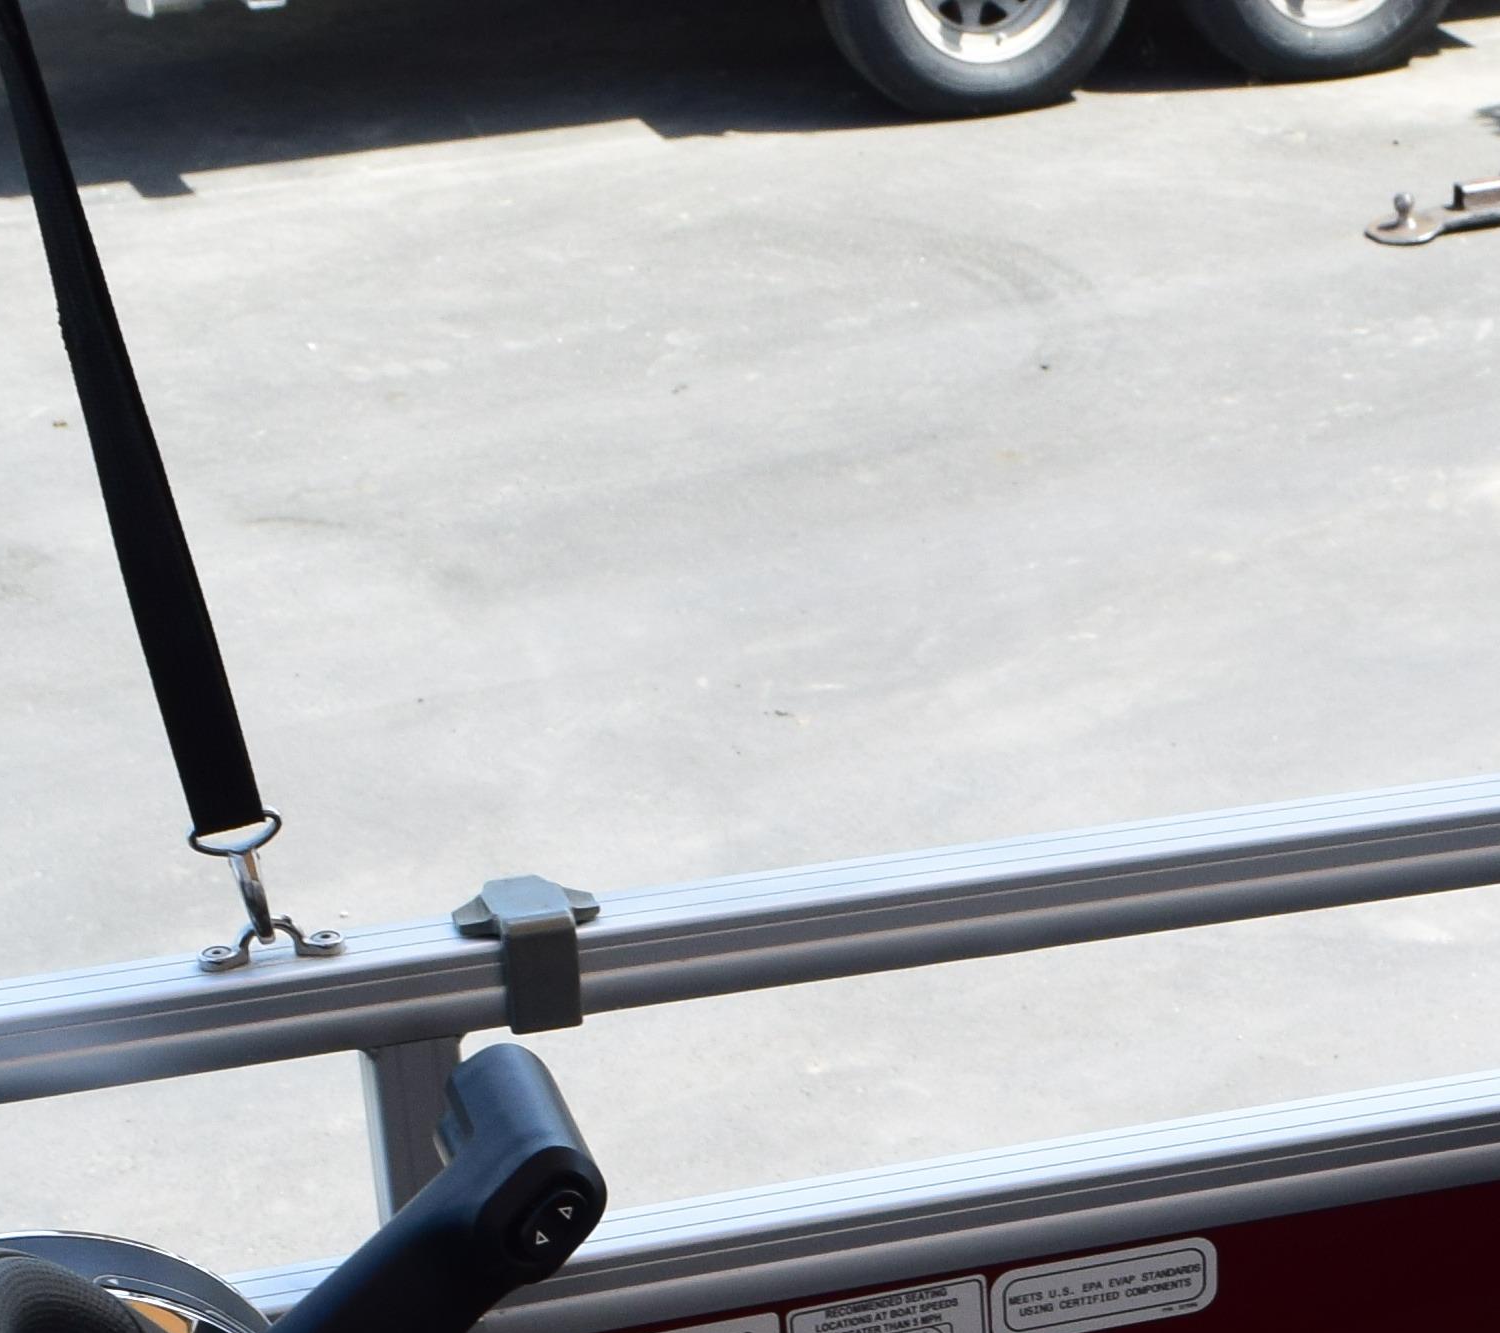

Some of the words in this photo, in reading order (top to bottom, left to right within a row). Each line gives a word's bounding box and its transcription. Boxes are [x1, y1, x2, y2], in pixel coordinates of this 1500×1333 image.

[1009, 1292, 1043, 1305] MEETS
[1049, 1287, 1074, 1298] U.S.
[1082, 1281, 1102, 1292] EPA
[1108, 1275, 1136, 1287] EVAP
[1141, 1263, 1201, 1281] STANDARDS
[1019, 1303, 1053, 1317] USING
[1059, 1291, 1119, 1309] CERTIFIED
[1125, 1278, 1191, 1297] COMPONENTS
[816, 1315, 871, 1332] LOCATIONS
[875, 1312, 887, 1321] AT
[890, 1306, 917, 1318] BOAT
[920, 1298, 958, 1312] SPEEDS
[825, 1296, 902, 1318] RECOMMENDED
[905, 1287, 947, 1302] SEATING
[884, 1320, 910, 1331] THAN
[922, 1314, 941, 1324] MPH
